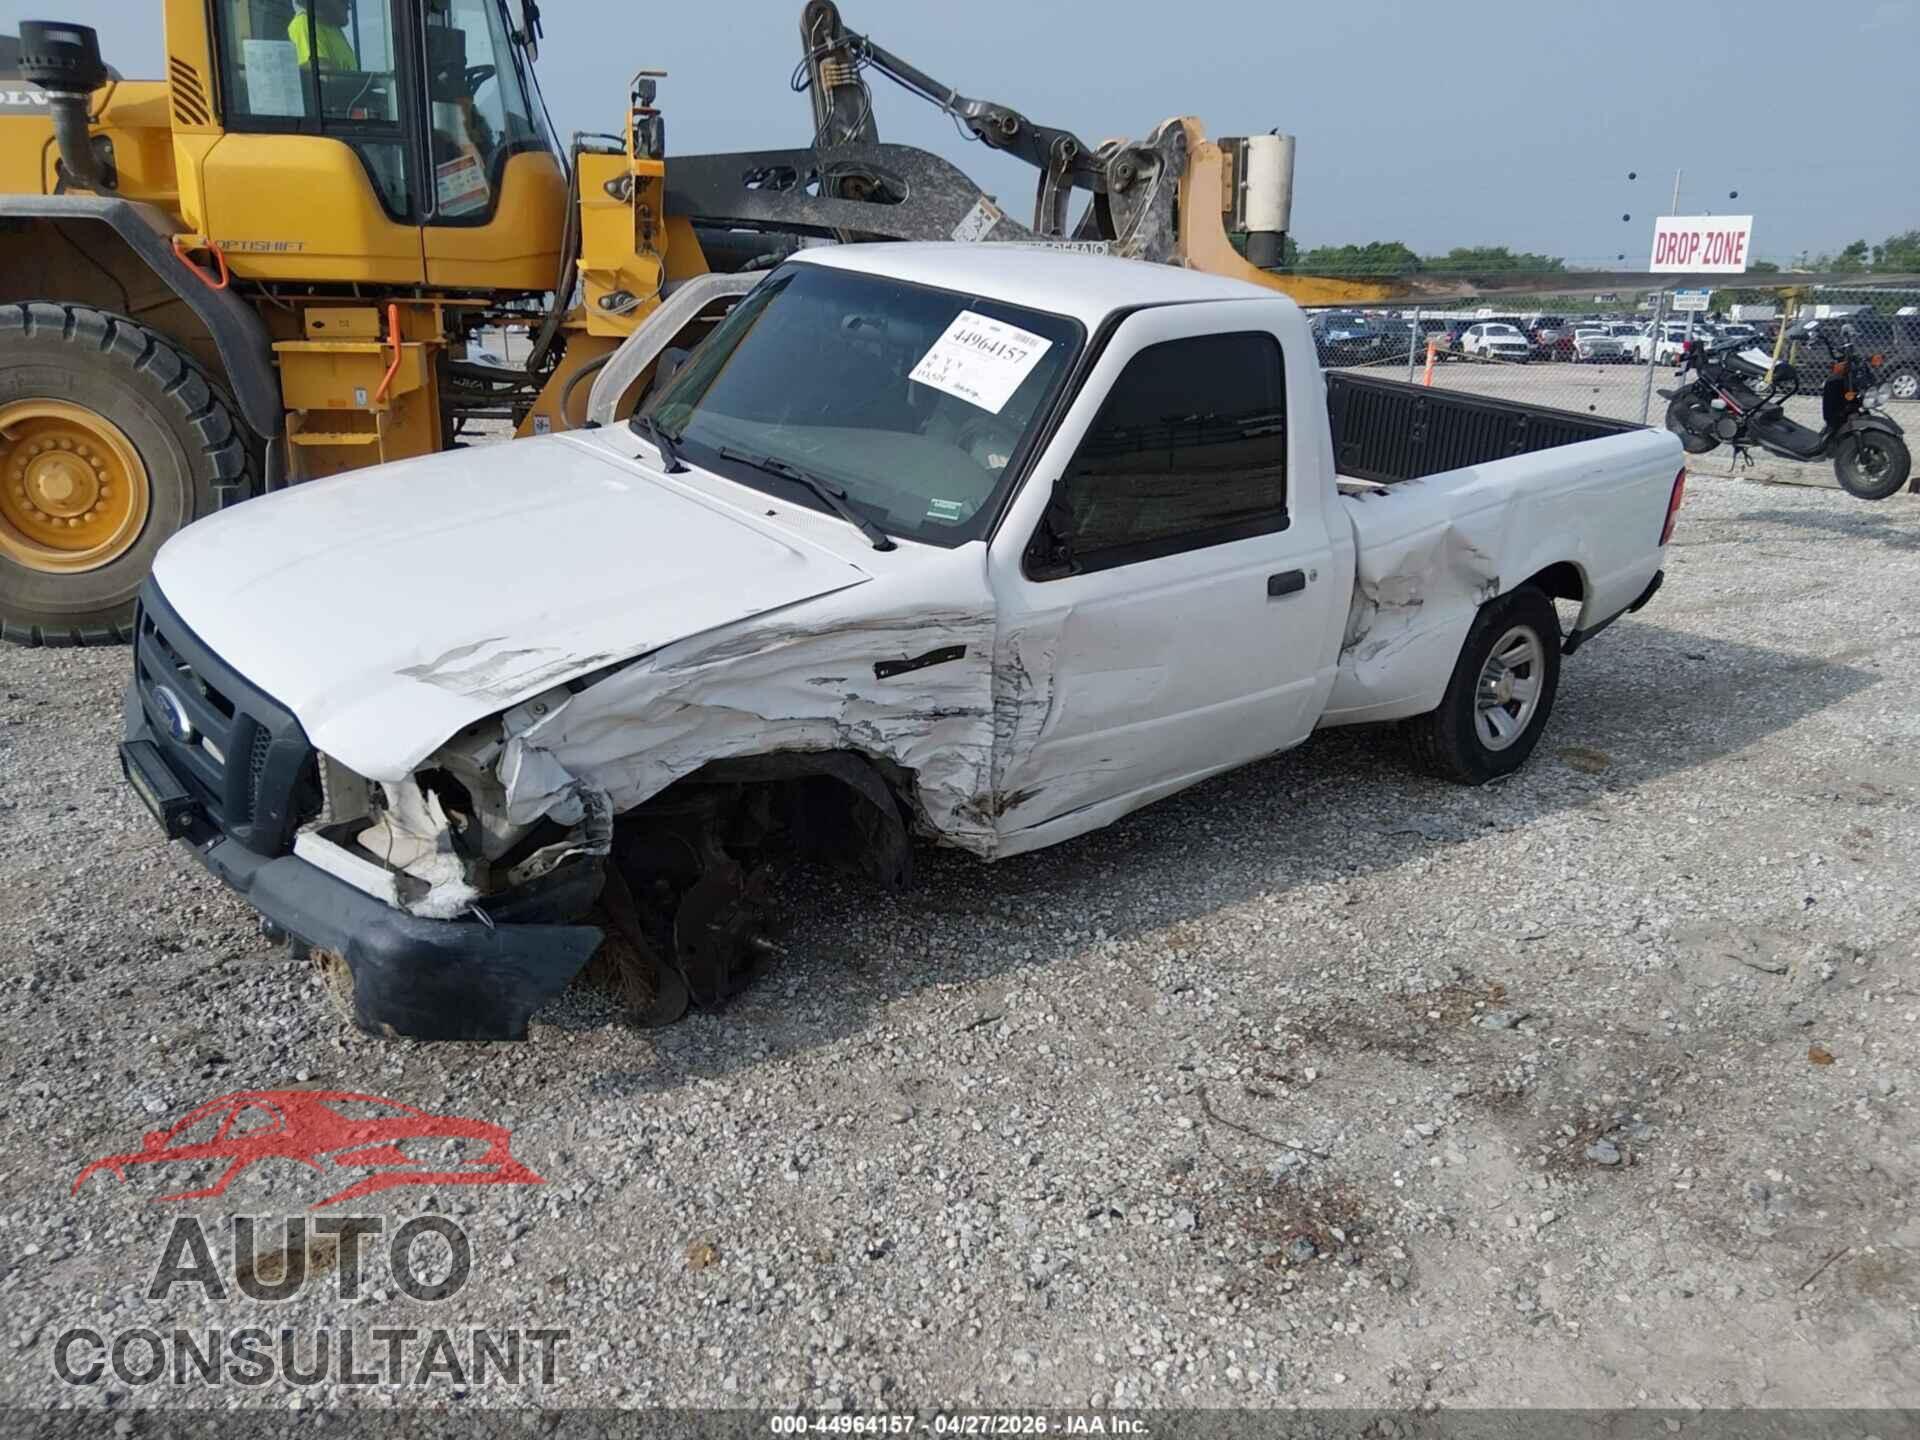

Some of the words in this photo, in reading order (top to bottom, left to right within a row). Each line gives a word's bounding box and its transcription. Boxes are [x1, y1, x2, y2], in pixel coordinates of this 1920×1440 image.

[1655, 231, 1700, 265] DROP
[1702, 231, 1746, 265] ZONE
[952, 328, 1028, 364] 44964157
